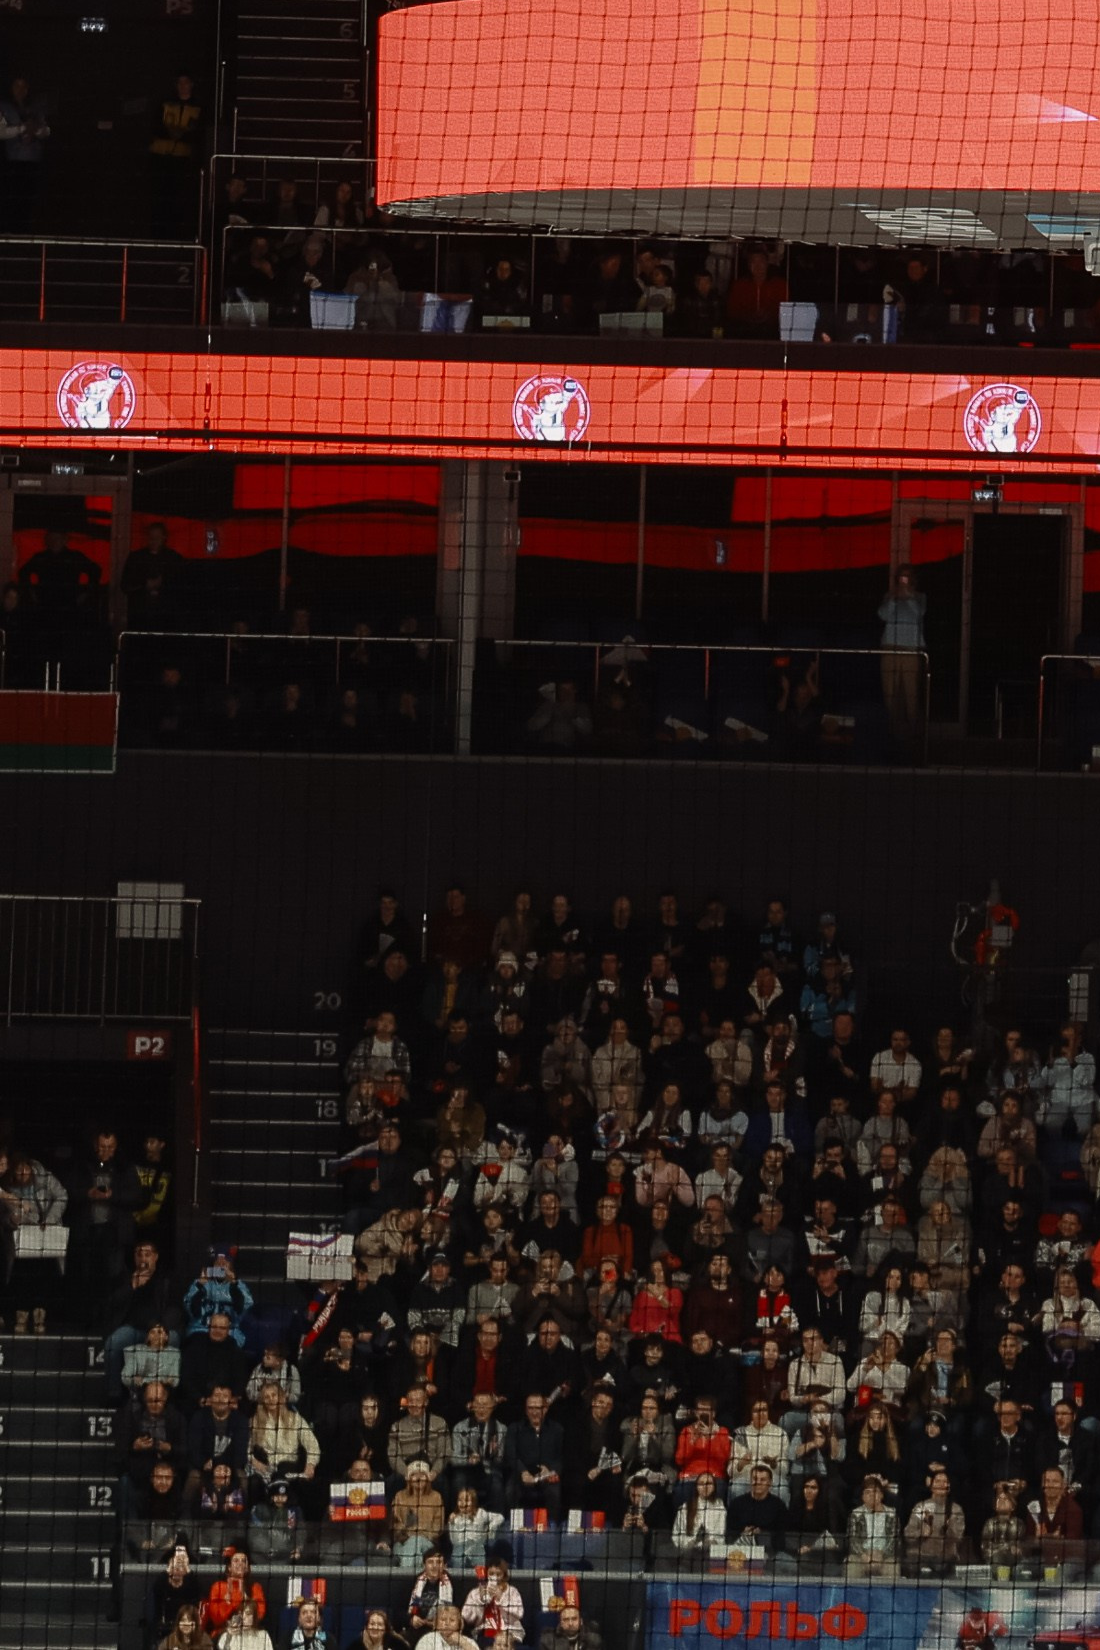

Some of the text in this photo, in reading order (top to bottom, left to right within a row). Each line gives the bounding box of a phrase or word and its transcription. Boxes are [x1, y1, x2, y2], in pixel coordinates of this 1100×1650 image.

[339, 23, 353, 39] 6
[344, 83, 355, 99] 5
[178, 266, 190, 283] 2
[314, 991, 341, 1010] 20
[314, 1039, 337, 1057] 19
[316, 1100, 338, 1118] 18
[88, 1416, 112, 1437] 13
[88, 1485, 112, 1506] 12
[90, 1557, 111, 1578] 11
[668, 1599, 867, 1640] РОЛЬФ
